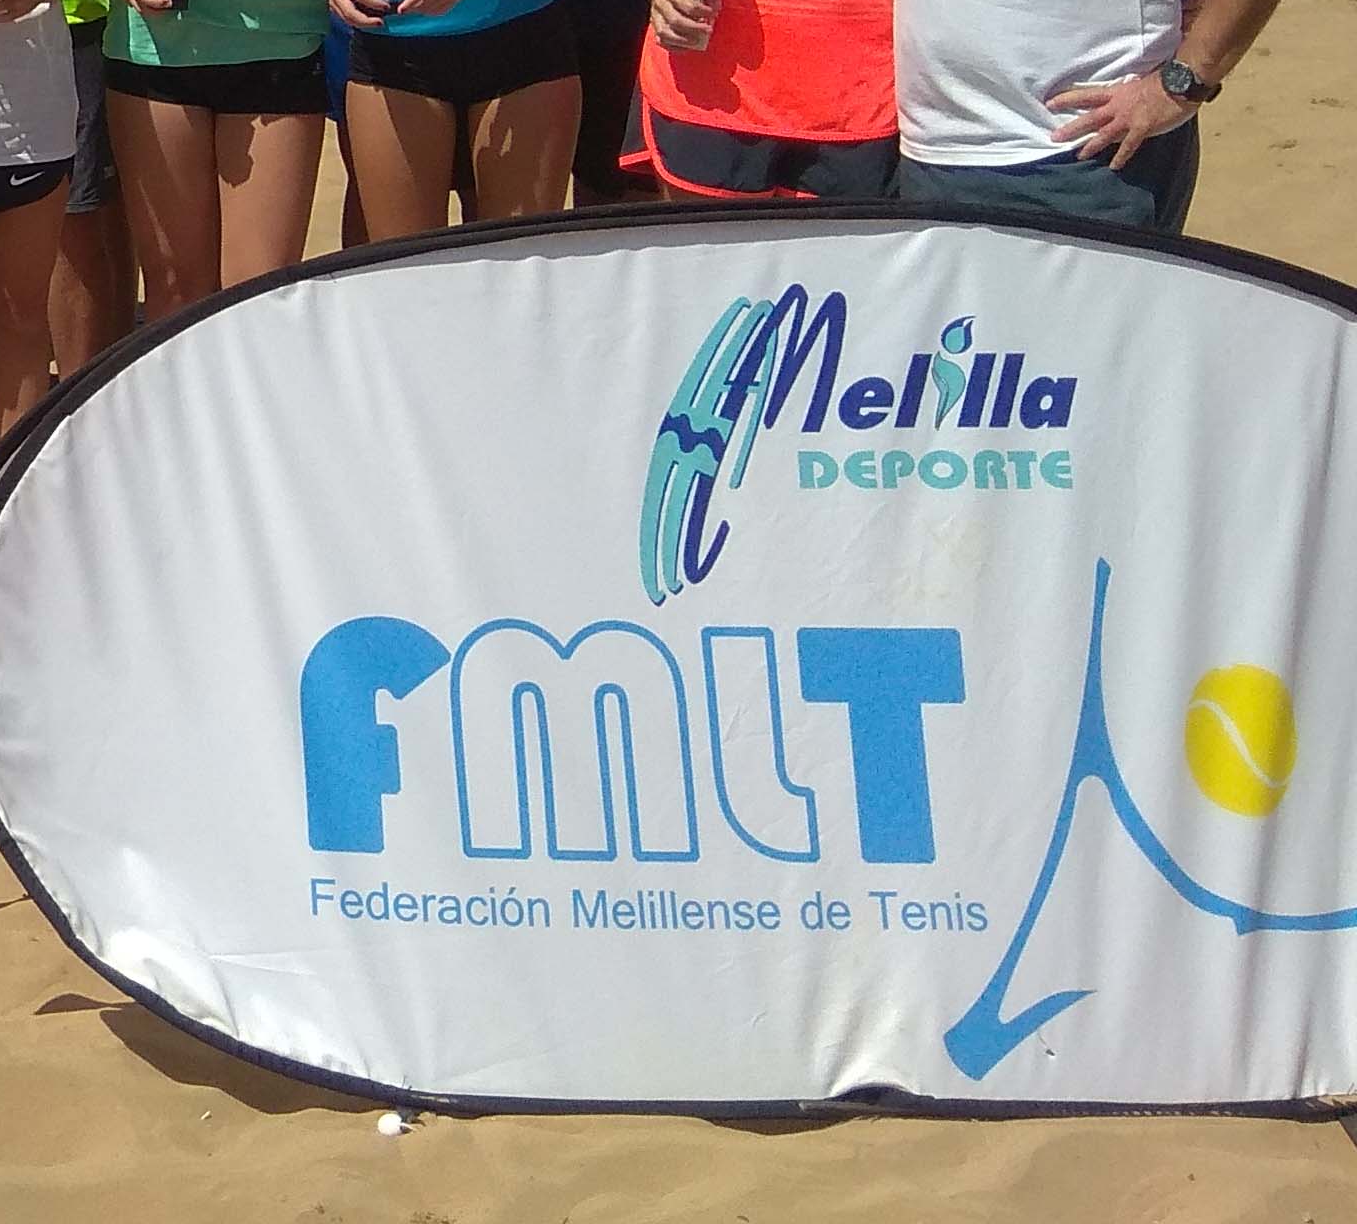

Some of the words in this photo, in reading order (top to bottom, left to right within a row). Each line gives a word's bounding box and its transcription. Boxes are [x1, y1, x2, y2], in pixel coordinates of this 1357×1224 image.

[762, 282, 1078, 433] Melilla
[797, 449, 1073, 490] DEPORTE
[309, 877, 551, 929] Federación
[571, 887, 782, 931] Melillense
[799, 888, 852, 931] de
[868, 890, 990, 933] Tenis
